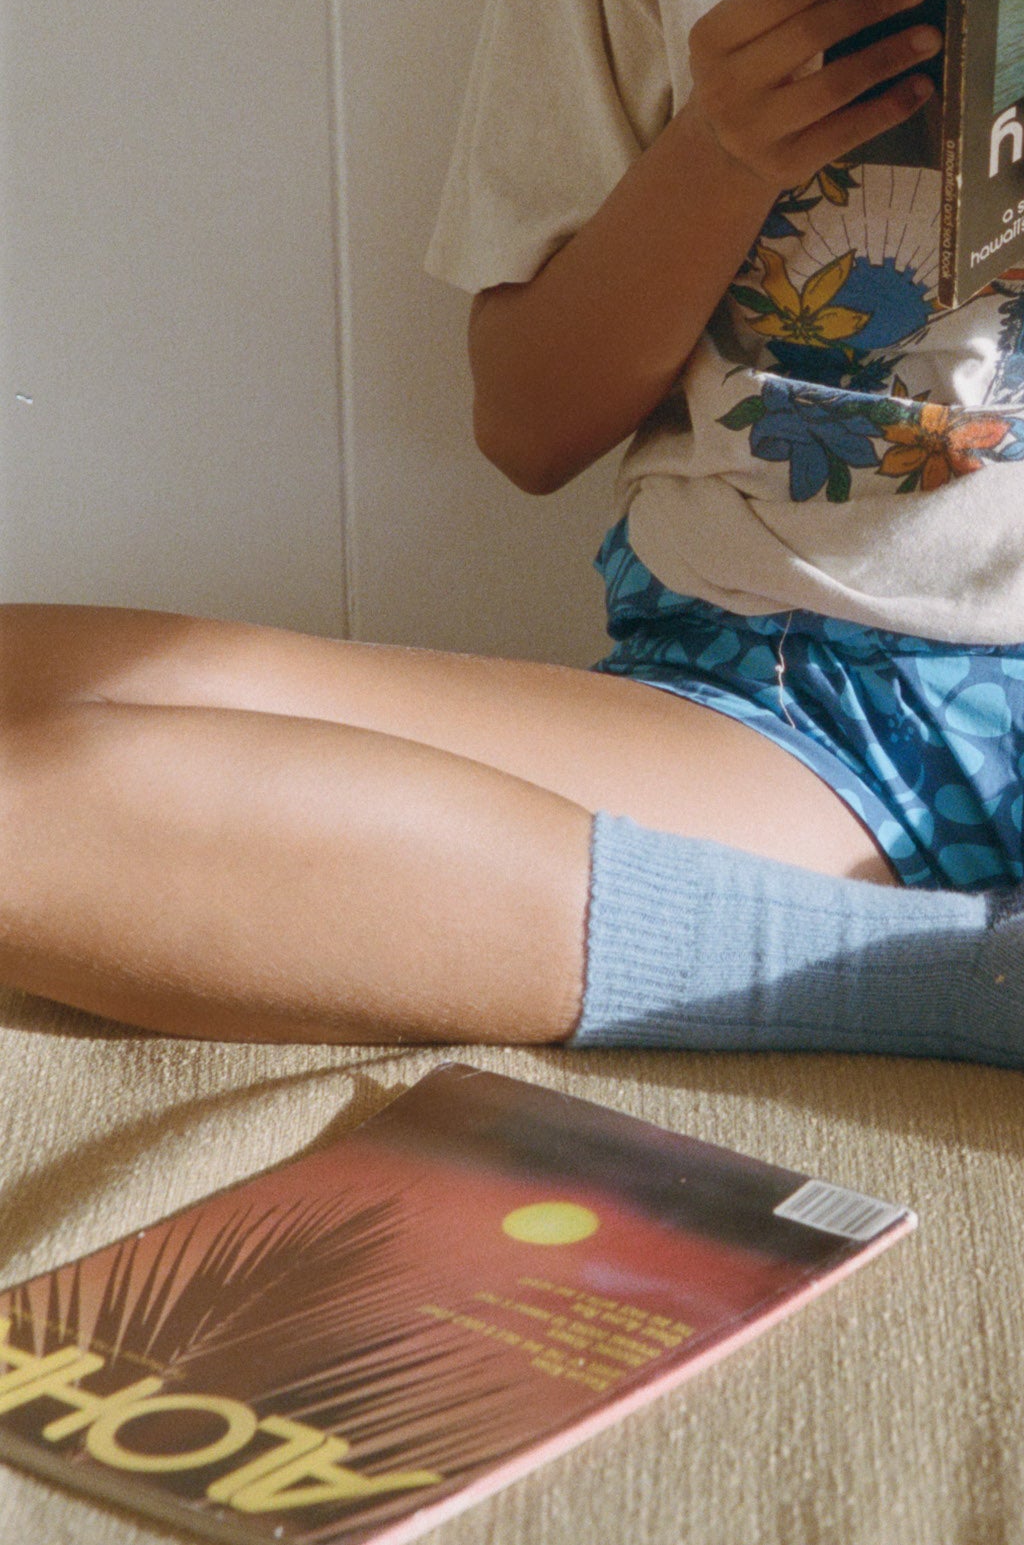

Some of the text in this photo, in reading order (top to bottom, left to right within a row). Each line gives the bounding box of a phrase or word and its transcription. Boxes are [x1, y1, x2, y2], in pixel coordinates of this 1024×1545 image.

[945, 149, 957, 202] mountain
[944, 203, 955, 225] and
[1002, 208, 1014, 224] a
[942, 227, 952, 249] sea
[941, 250, 953, 280] book
